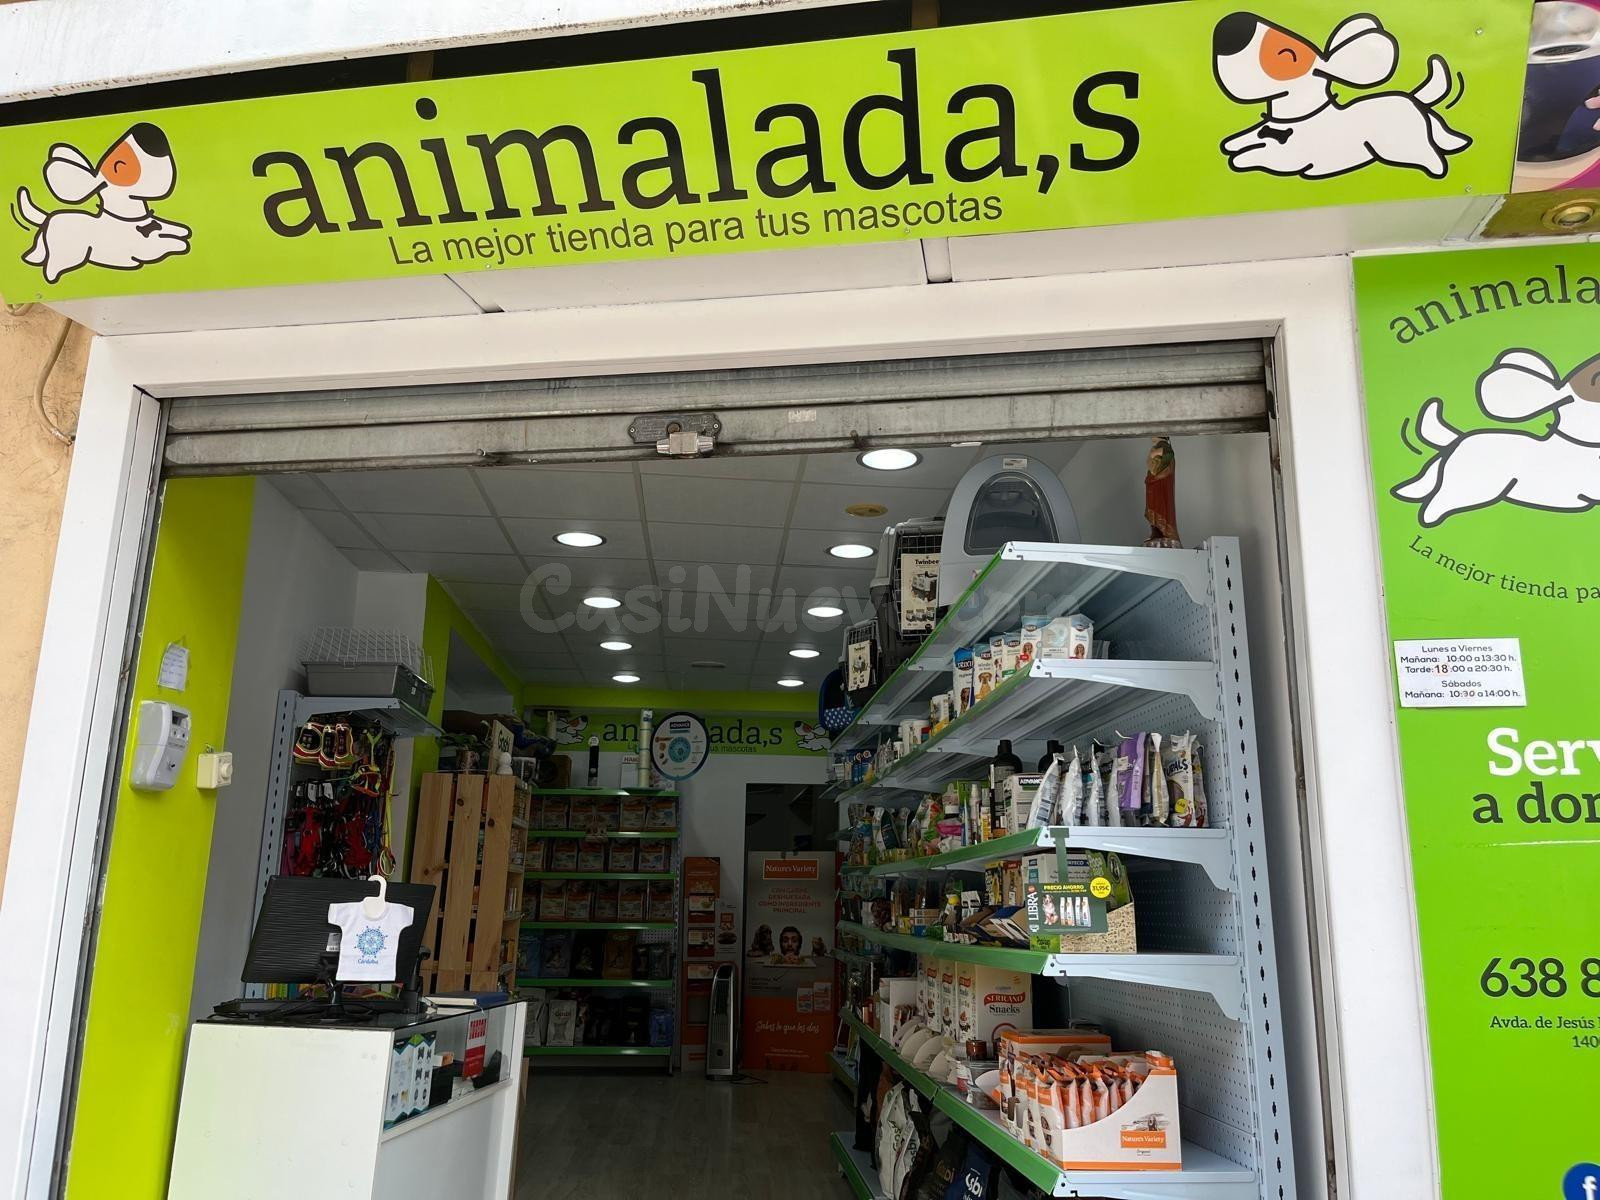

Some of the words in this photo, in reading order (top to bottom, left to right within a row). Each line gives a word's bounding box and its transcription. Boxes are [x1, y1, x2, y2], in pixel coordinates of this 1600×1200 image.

[252, 49, 1140, 238] animalada,s
[388, 235, 433, 265] La
[445, 227, 536, 265] mejor
[545, 217, 654, 253] tienda
[665, 215, 745, 252] para
[755, 208, 810, 238] tus
[823, 192, 1003, 233] mascotas
[1409, 535, 1433, 560] La
[1435, 551, 1496, 587] mejor
[1500, 574, 1569, 599] tienda
[1421, 645, 1449, 653] Lunes
[1400, 656, 1440, 664] Mañana:
[1446, 655, 1473, 663] 10:00
[1481, 654, 1507, 662] 13:30
[1405, 666, 1434, 674] Tarde:
[1441, 680, 1482, 688] Sábados
[1405, 691, 1445, 699] Mañana:
[603, 718, 782, 747] anada,s
[1020, 778, 1043, 787] ADVANC
[1472, 793, 1503, 824] a
[1027, 891, 1039, 921] LIBRA
[1480, 957, 1567, 998] 638
[1580, 957, 1600, 998] 8
[989, 1004, 1021, 1014] Snacks
[1490, 1016, 1532, 1028] Avda.
[1535, 1016, 1552, 1028] de
[1556, 1016, 1595, 1028] Jesús
[1572, 1035, 1600, 1048] 140
